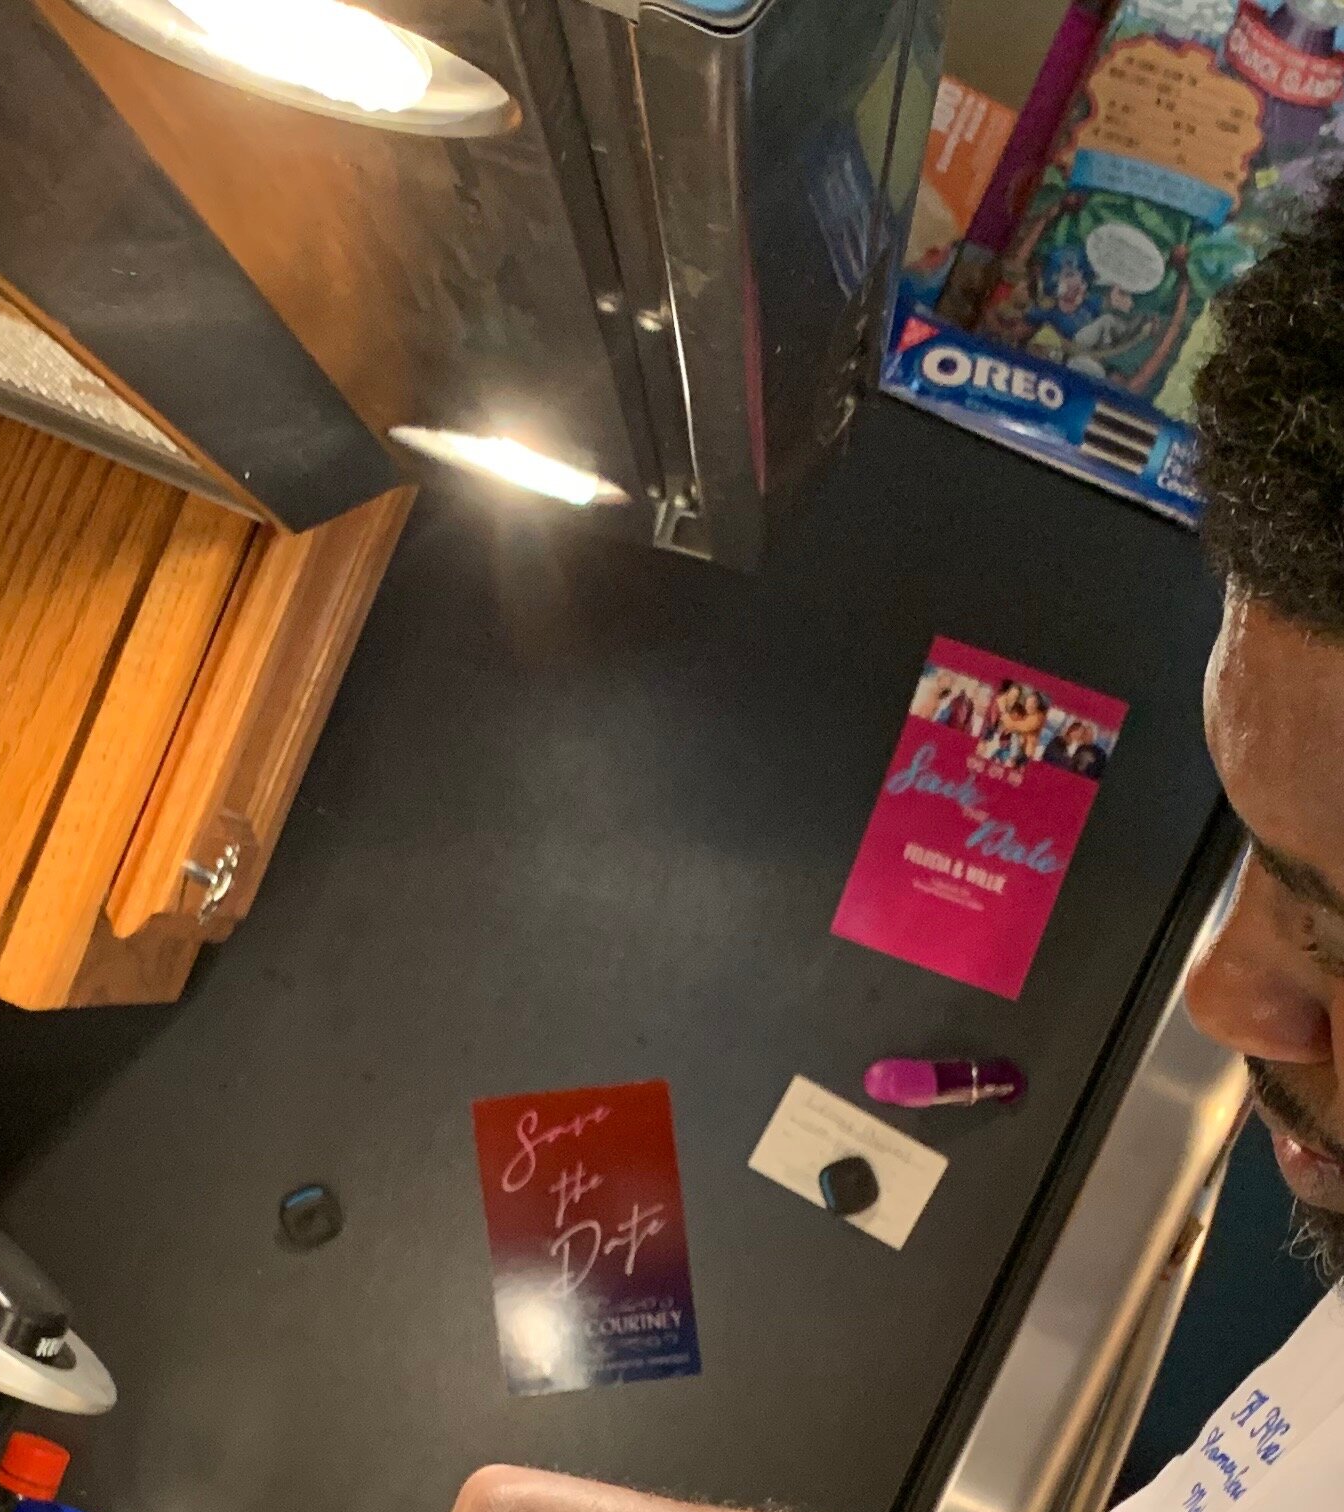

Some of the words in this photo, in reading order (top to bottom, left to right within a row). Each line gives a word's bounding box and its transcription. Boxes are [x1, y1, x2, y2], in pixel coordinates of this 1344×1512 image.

[922, 345, 1063, 411] OREO
[502, 1105, 612, 1193] Save
[548, 1159, 604, 1229] the
[549, 1203, 667, 1298] Date
